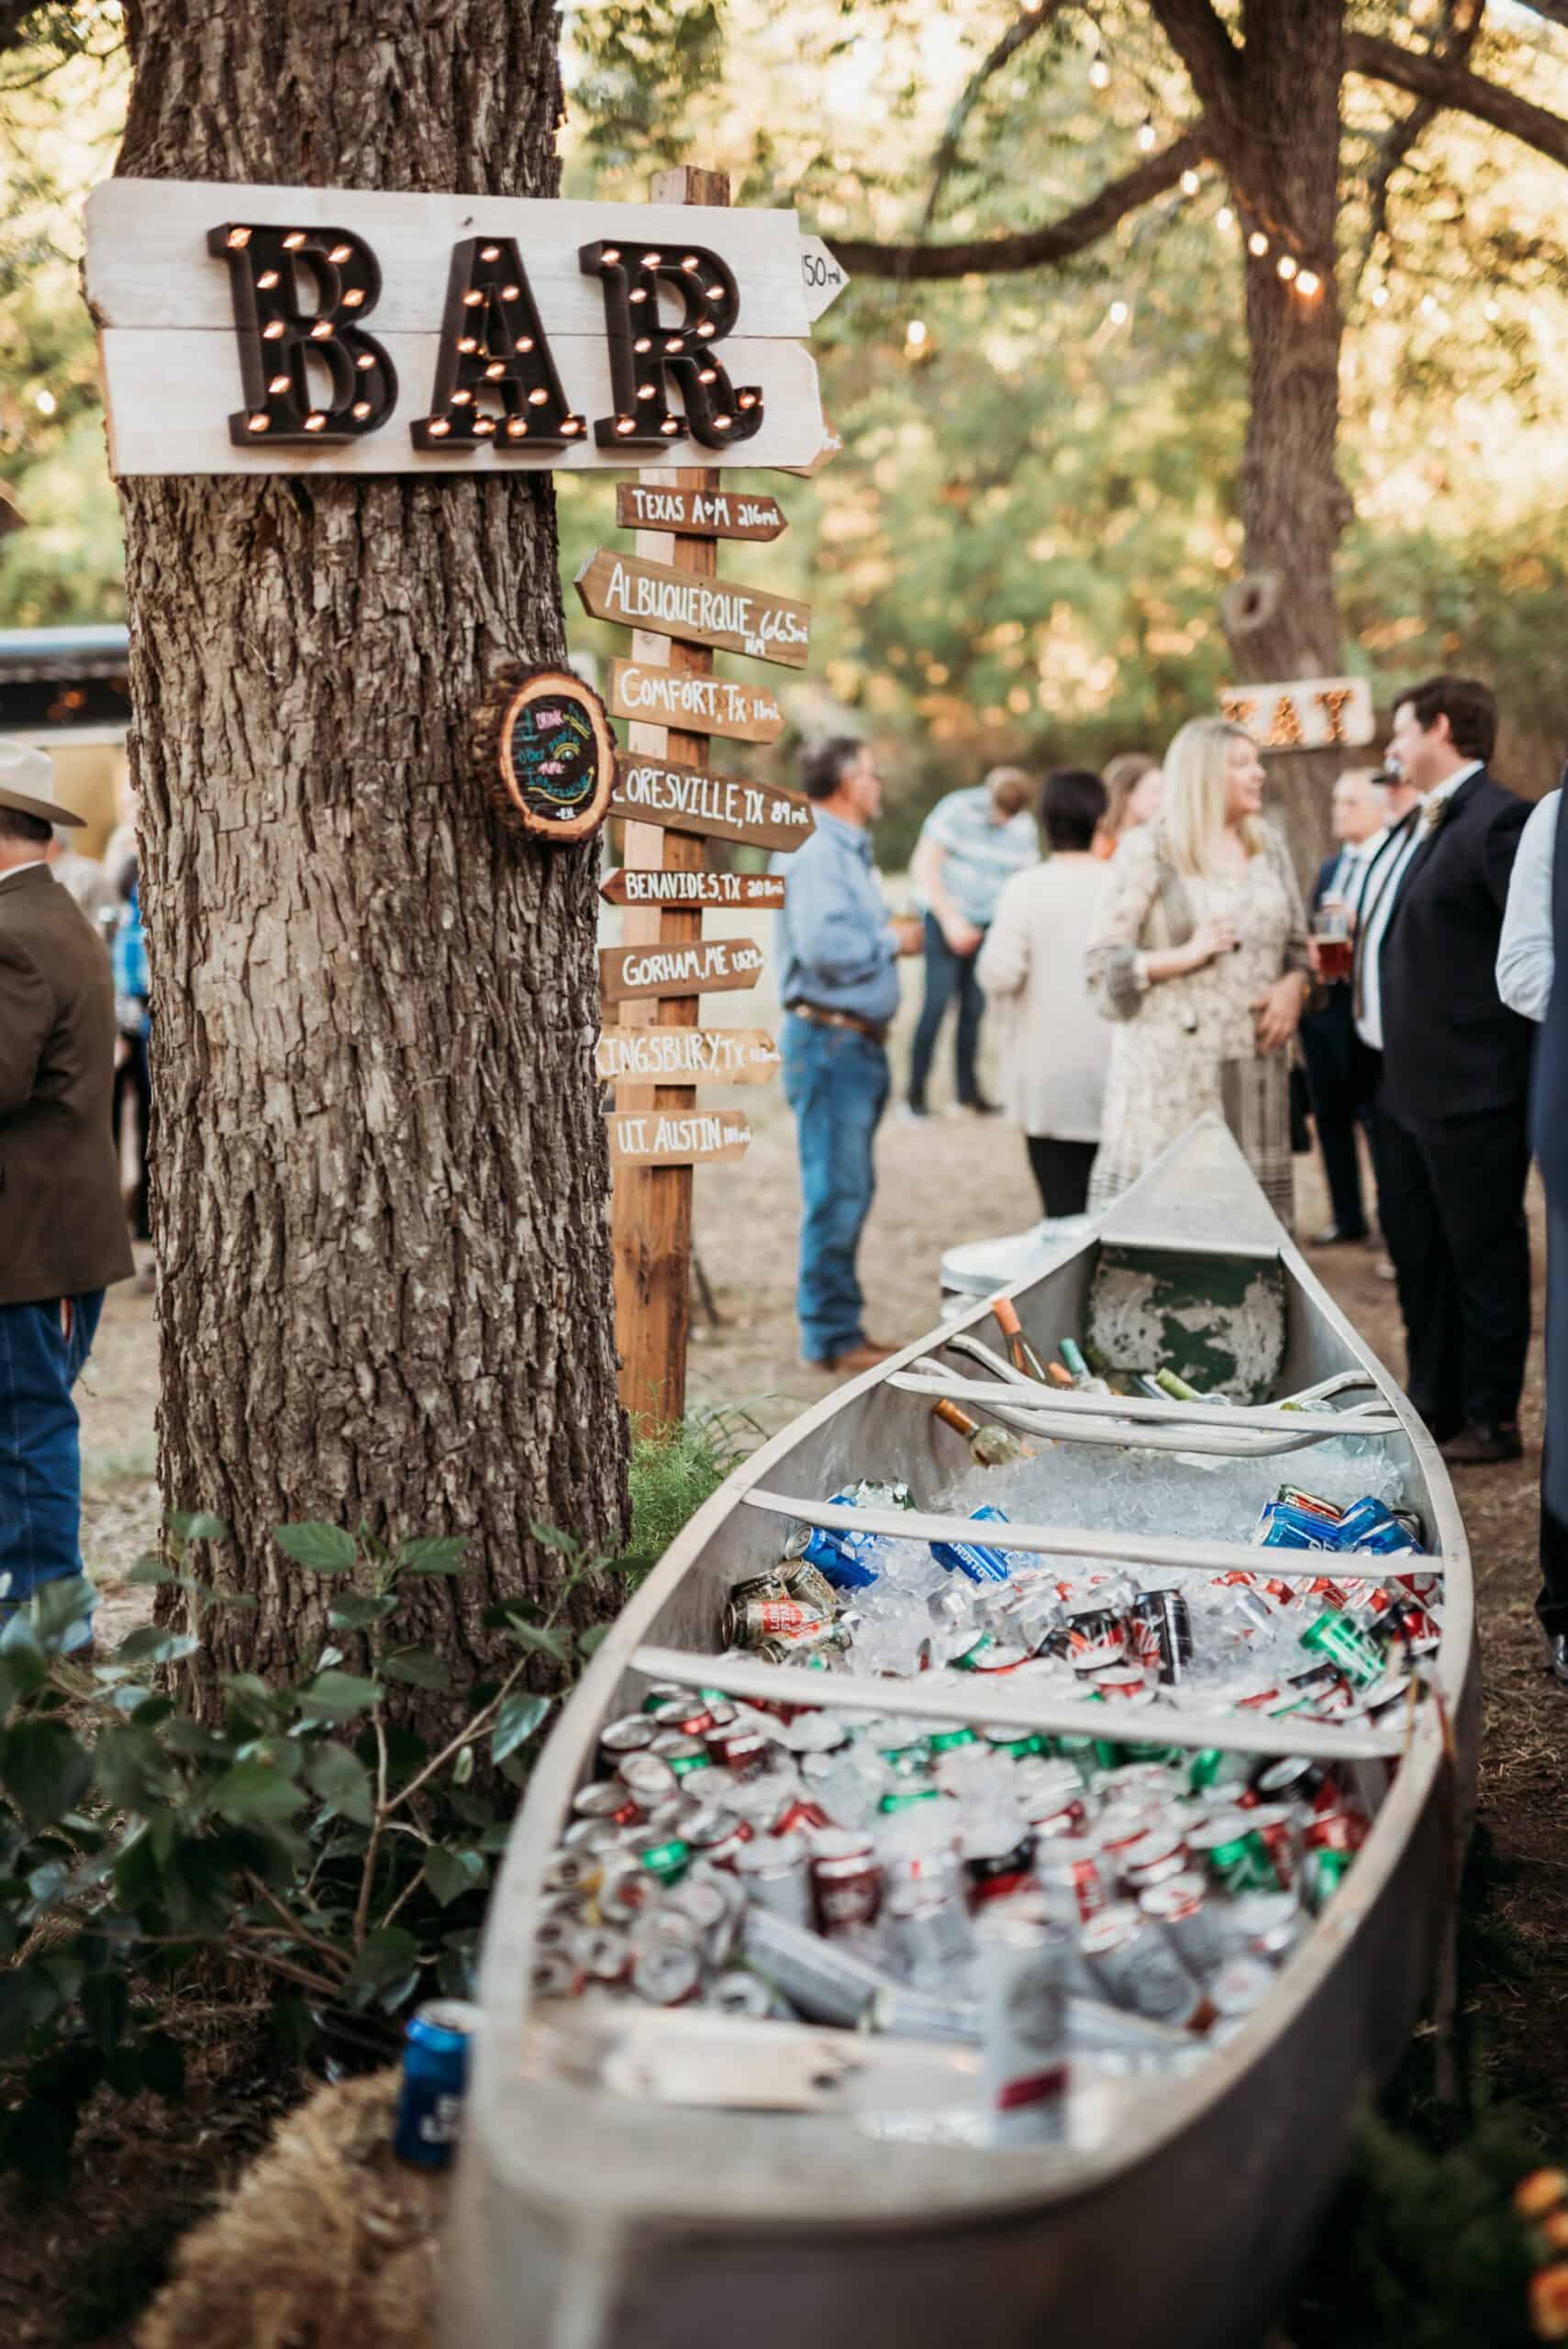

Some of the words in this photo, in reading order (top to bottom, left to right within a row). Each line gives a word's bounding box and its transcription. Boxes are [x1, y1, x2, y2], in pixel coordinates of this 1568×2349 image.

[208, 222, 764, 451] BAR
[631, 489, 685, 523] TEXAS
[771, 800, 809, 826] 89mi
[653, 1116, 722, 1153] AUSTIN
